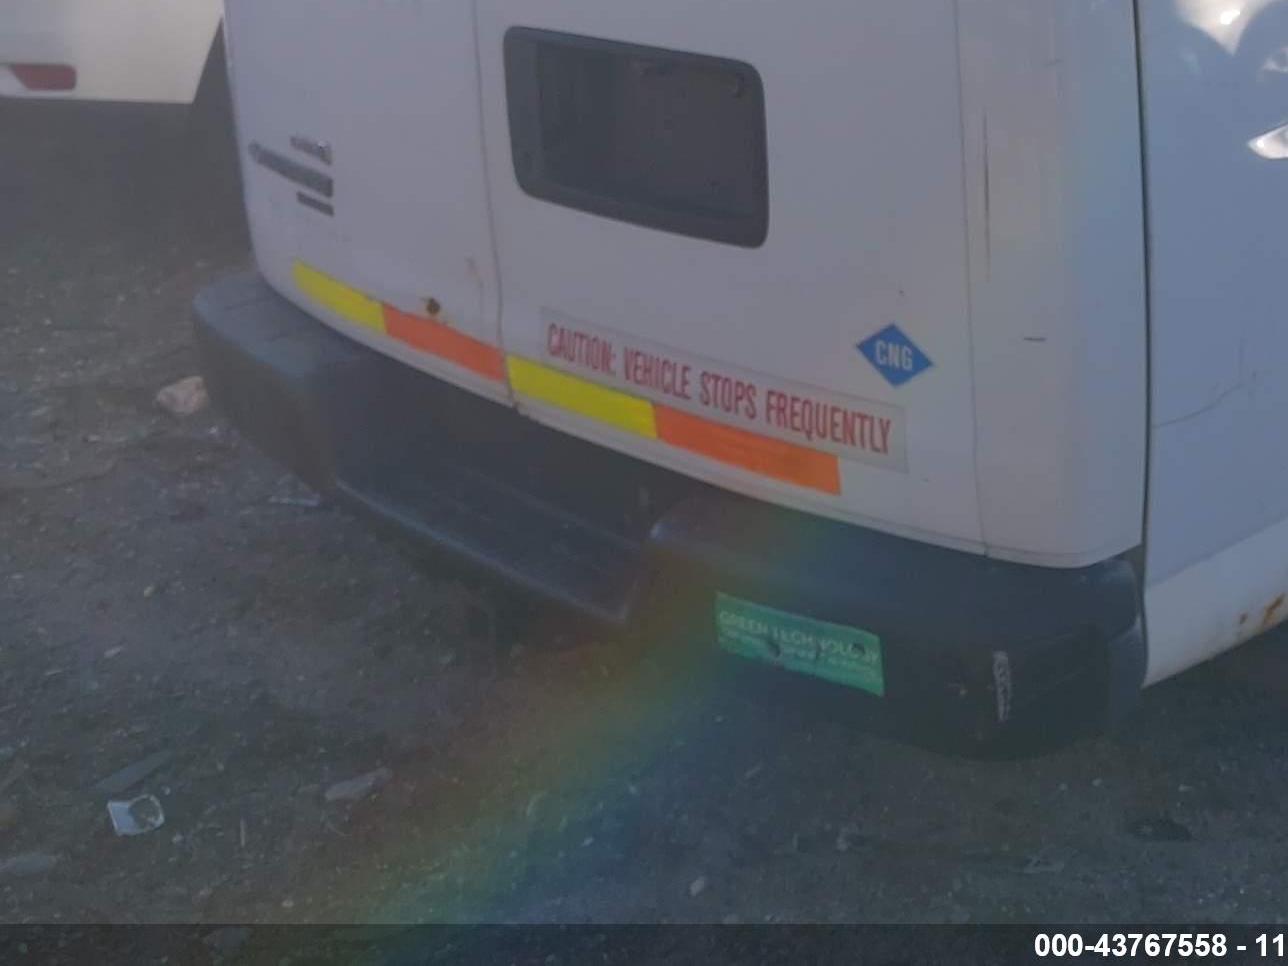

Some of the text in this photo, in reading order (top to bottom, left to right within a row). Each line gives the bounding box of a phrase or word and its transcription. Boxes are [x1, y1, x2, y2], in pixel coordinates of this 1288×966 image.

[875, 340, 913, 371] CNG
[623, 345, 691, 400] VEHICLE
[700, 370, 757, 420] STOPS
[764, 389, 891, 454] FREQUENTLY
